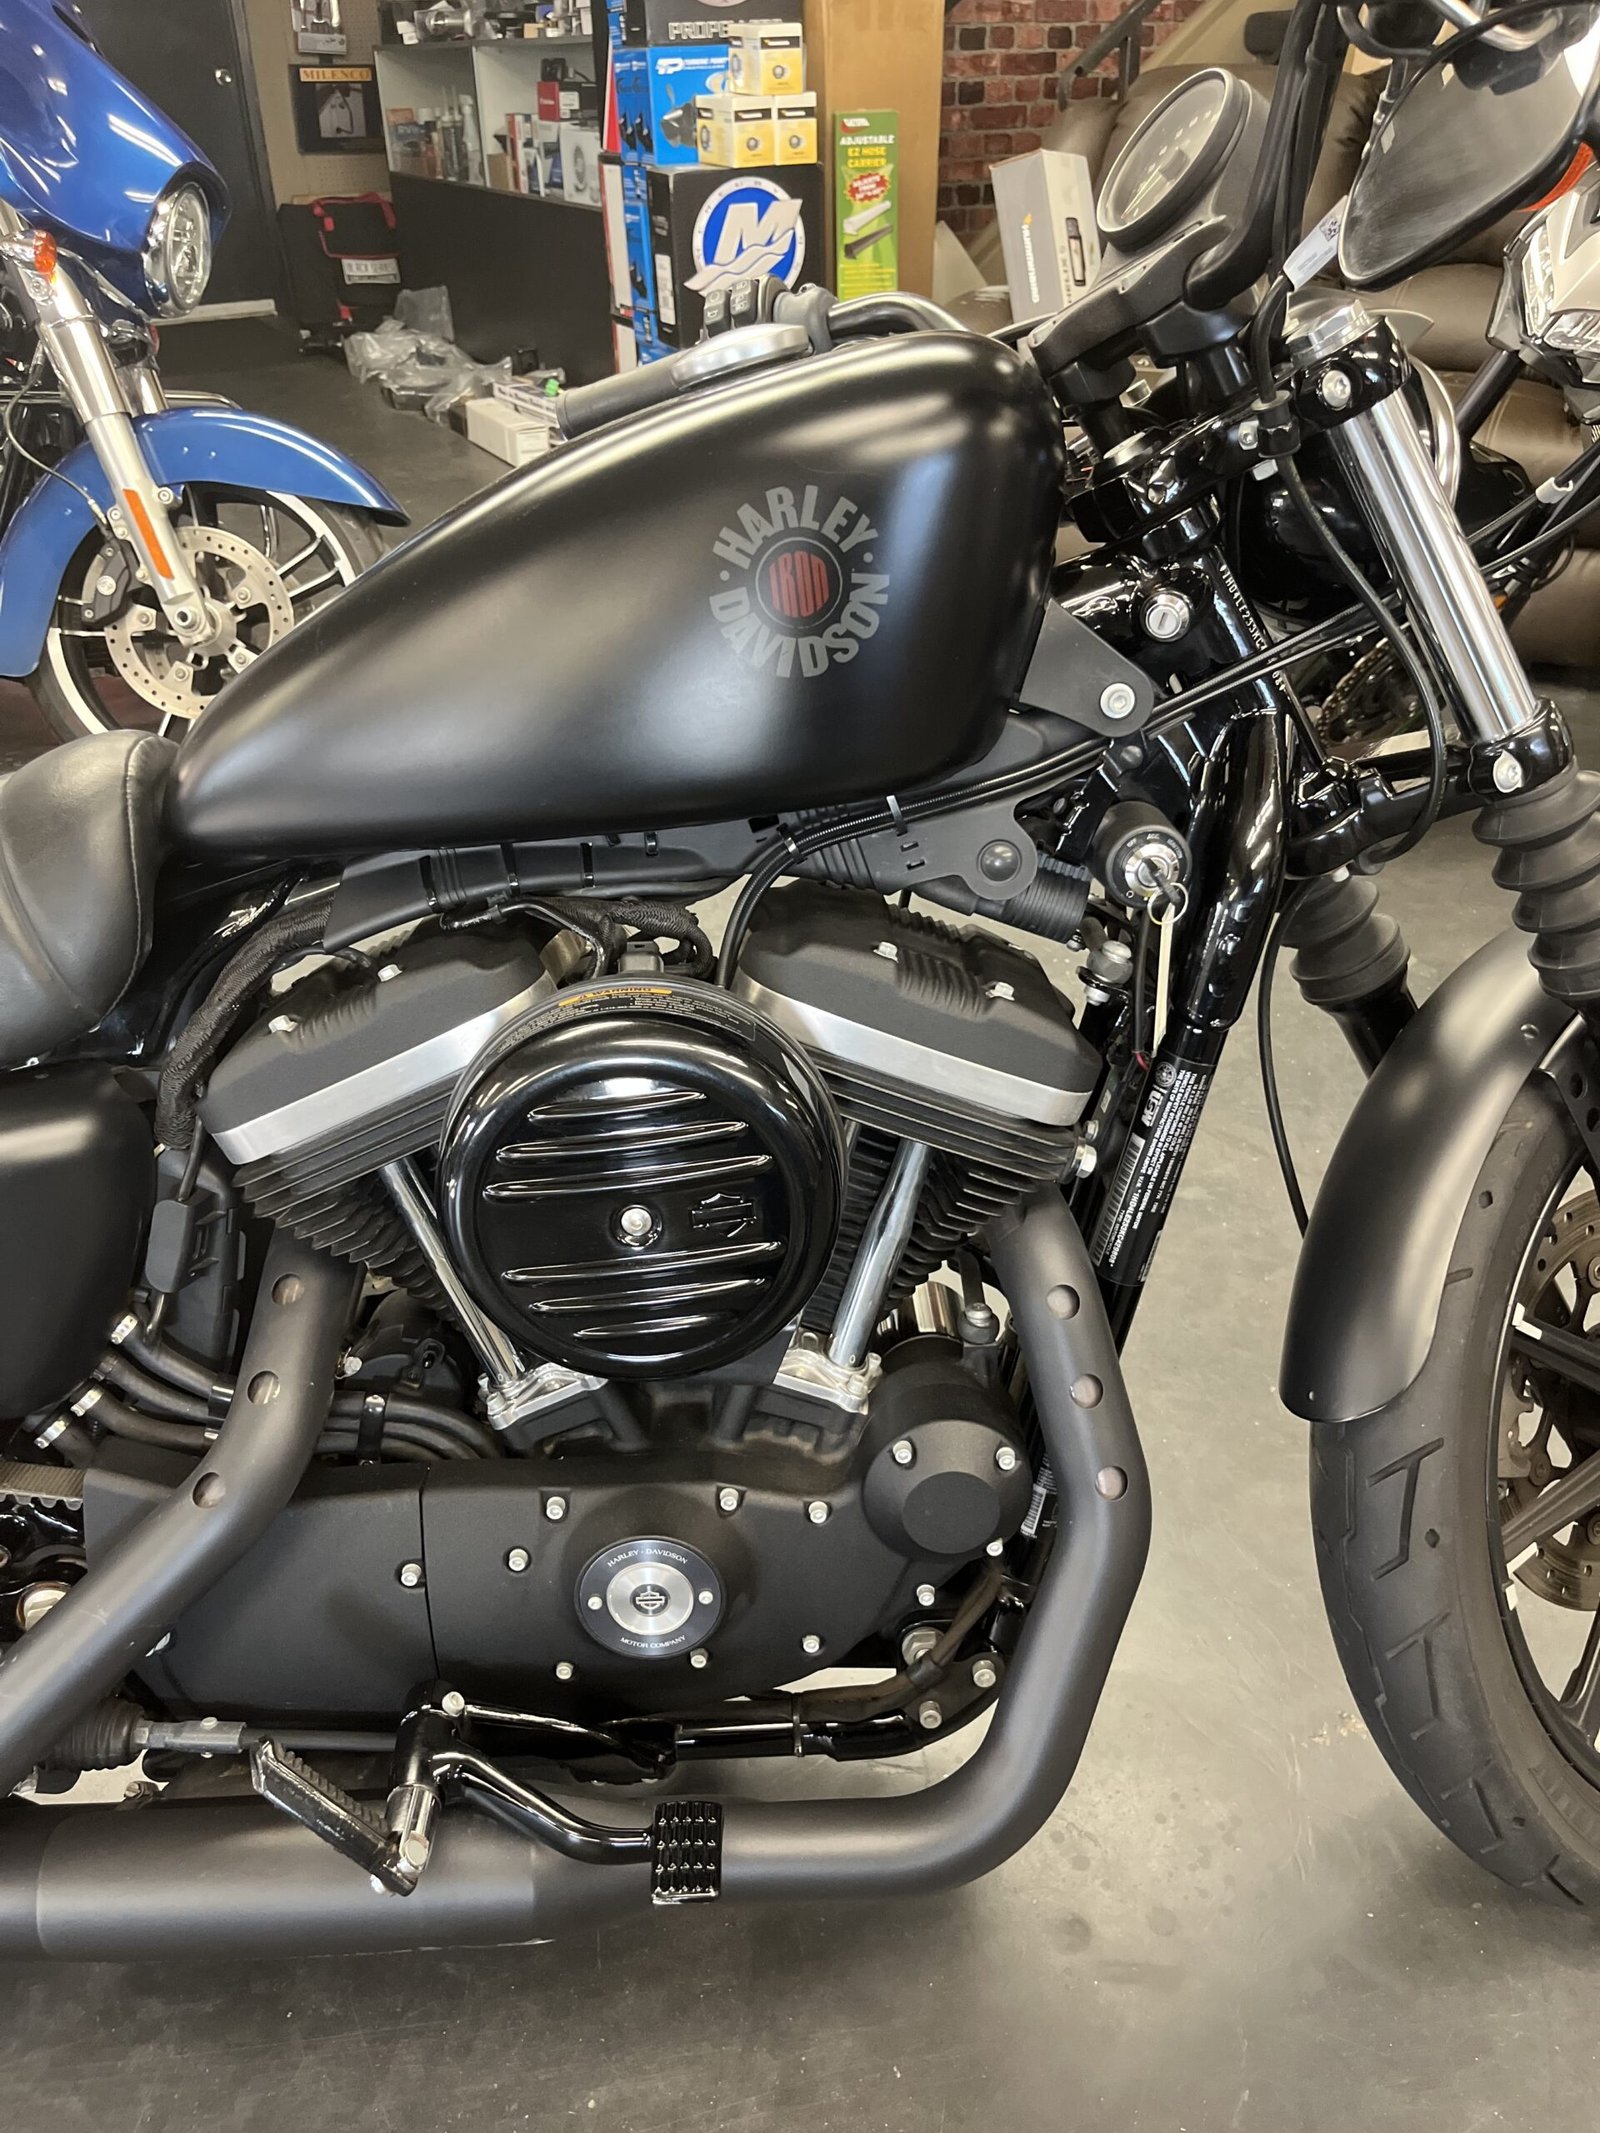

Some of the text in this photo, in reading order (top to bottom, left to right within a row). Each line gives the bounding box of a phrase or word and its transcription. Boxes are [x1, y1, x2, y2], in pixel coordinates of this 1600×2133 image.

[302, 69, 370, 80] MILENCO
[839, 134, 896, 146] ADJUSTABLE
[712, 484, 879, 570] HARLEY
[709, 572, 890, 678] DAVIDSON
[592, 987, 652, 996] WARNING
[607, 1548, 689, 1568] HARLEY DAVIDSON
[620, 1634, 686, 1649] MOTOR COMPANY
